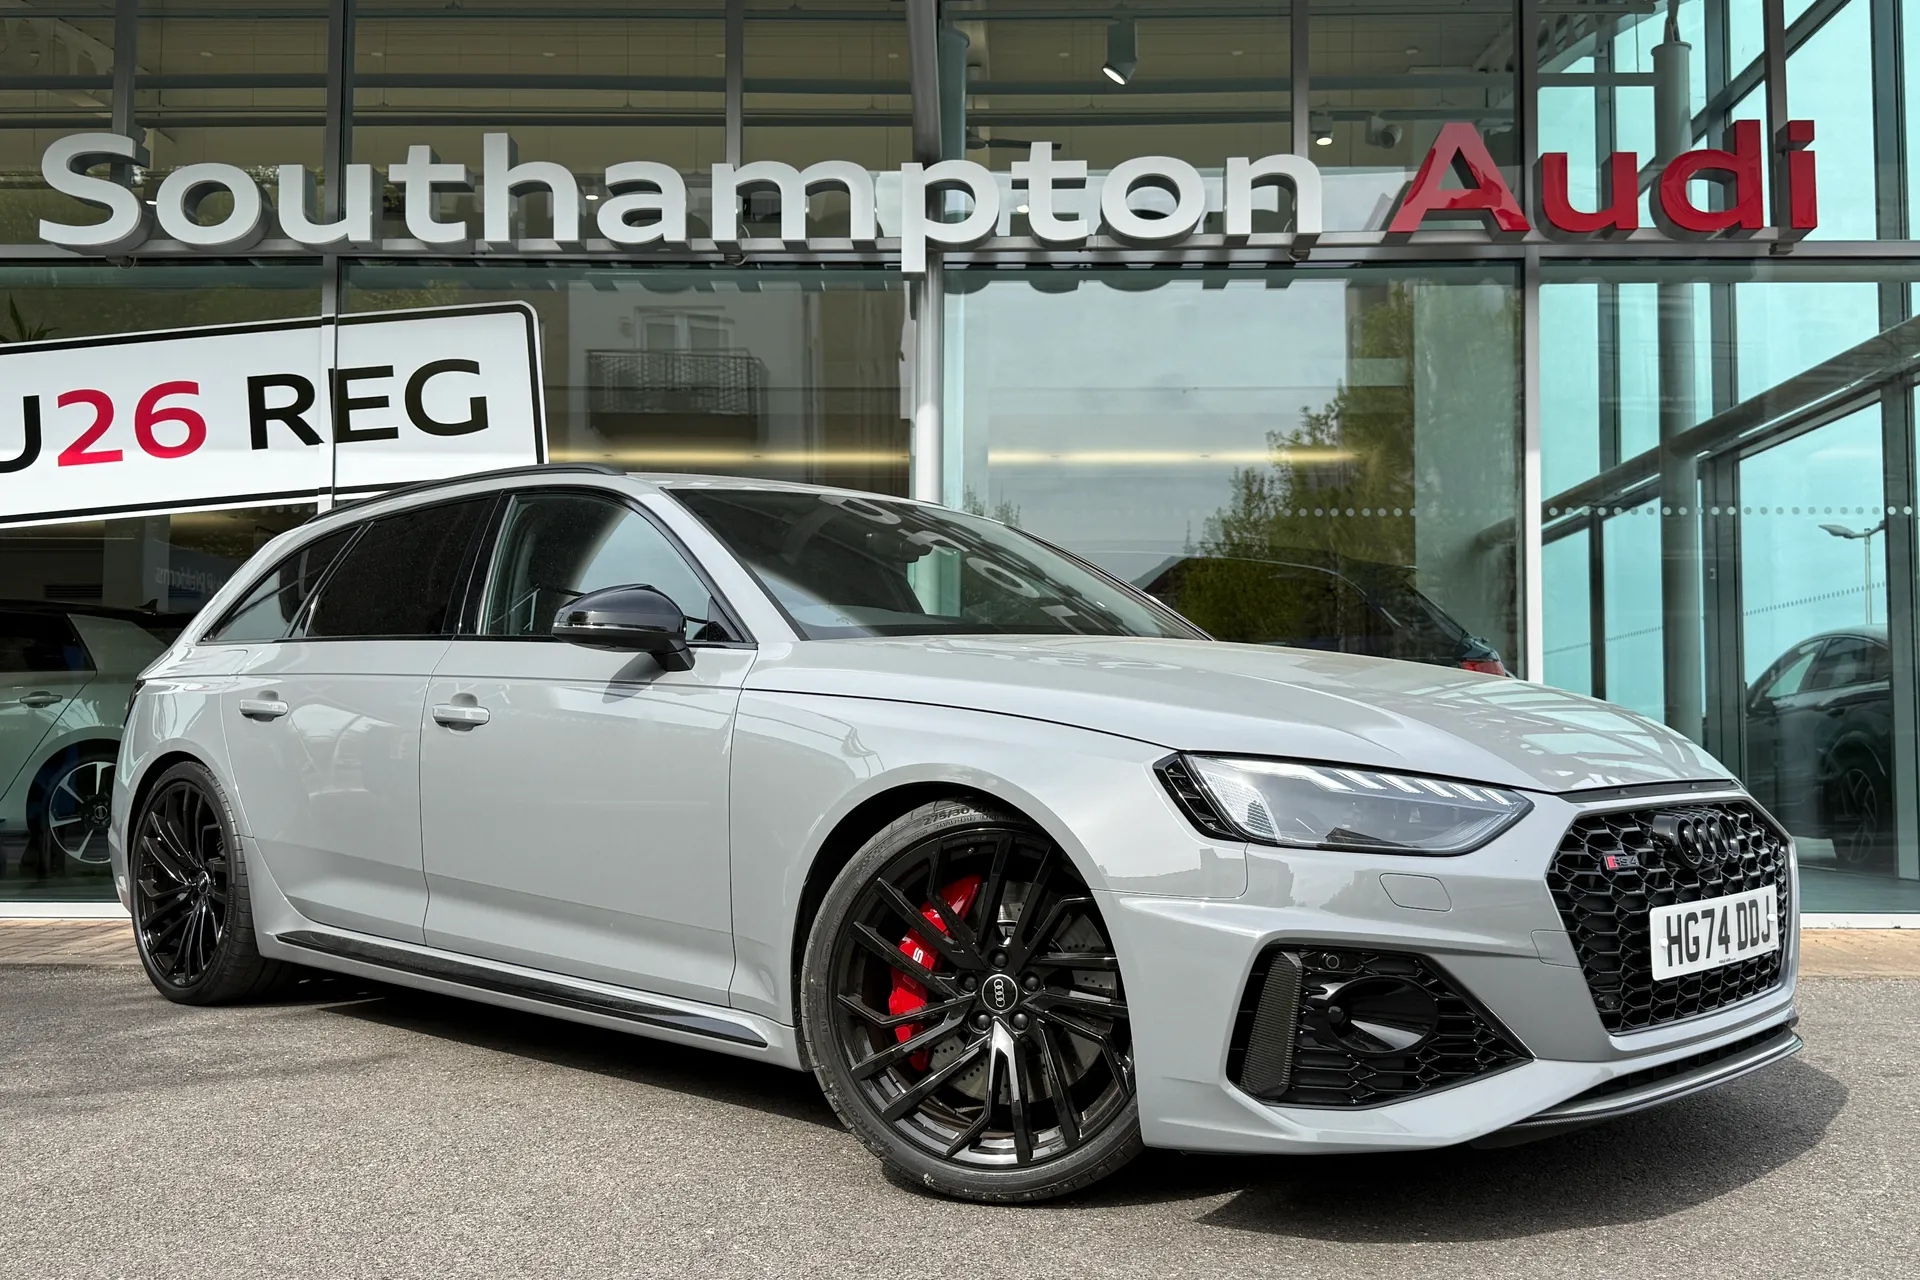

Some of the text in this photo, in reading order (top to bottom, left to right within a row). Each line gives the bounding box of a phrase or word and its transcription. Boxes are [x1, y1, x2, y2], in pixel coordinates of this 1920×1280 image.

[38, 120, 1819, 273] Southampton Audi
[247, 358, 489, 450] REG
[1666, 895, 1770, 967] HG74 DDJ
